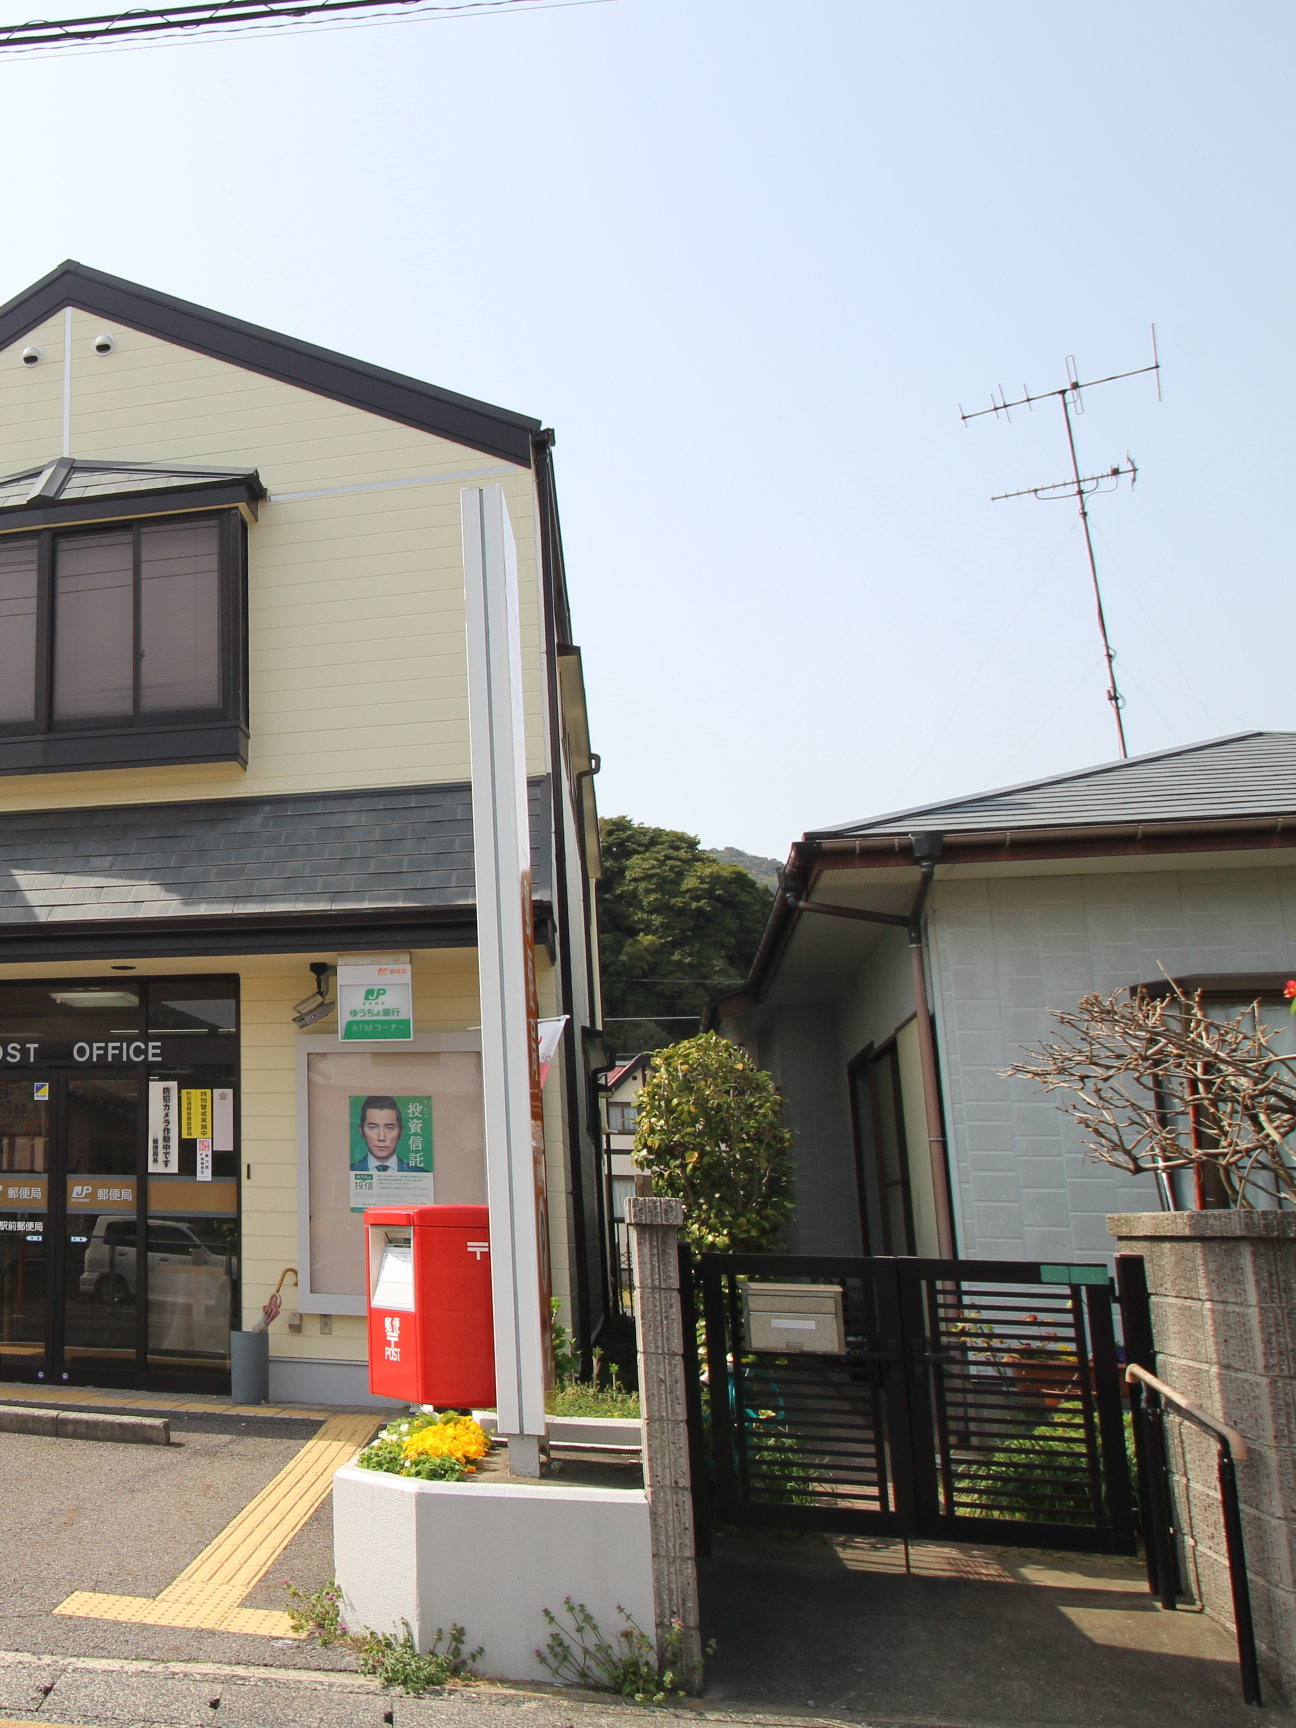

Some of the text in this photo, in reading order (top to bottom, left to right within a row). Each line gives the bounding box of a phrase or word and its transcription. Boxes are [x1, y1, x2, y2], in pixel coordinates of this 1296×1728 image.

[364, 988, 387, 1001] JP
[349, 1008, 401, 1018] ゆうちょ銀行
[351, 1024, 406, 1032] ATMコーナー
[73, 1042, 162, 1062] OFFICE
[162, 1086, 171, 1168] 防犯カメラ作動中です
[407, 1102, 424, 1167] 投資信託
[71, 1186, 92, 1198] JP
[354, 1181, 374, 1191] 投信
[7, 1187, 42, 1200] 郵便局
[97, 1188, 133, 1202] 郵便局
[384, 1346, 401, 1362] POST
